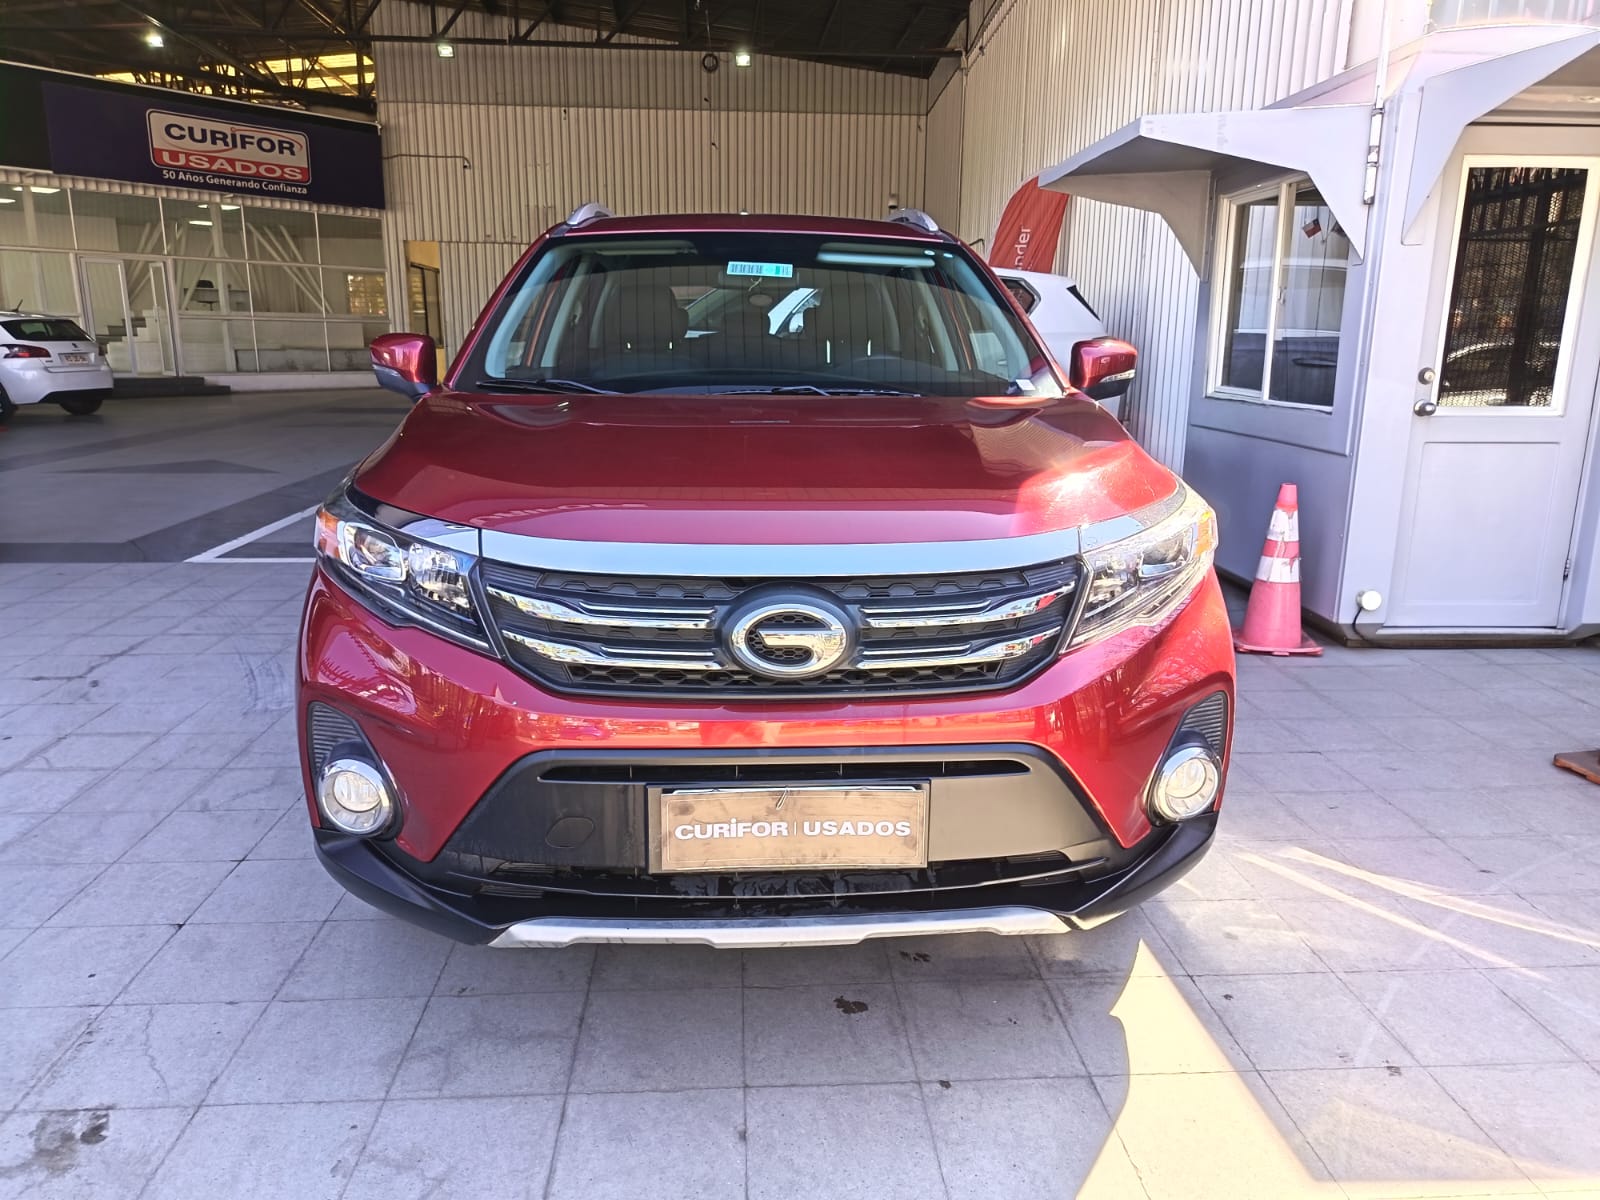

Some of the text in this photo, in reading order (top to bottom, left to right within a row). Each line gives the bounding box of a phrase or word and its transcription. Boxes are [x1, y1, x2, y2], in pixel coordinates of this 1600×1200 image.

[165, 123, 296, 156] CURIFOR
[161, 151, 303, 180] USADOS
[162, 170, 308, 194] 50 Años Generando Confianza
[803, 821, 911, 837] USADOS
